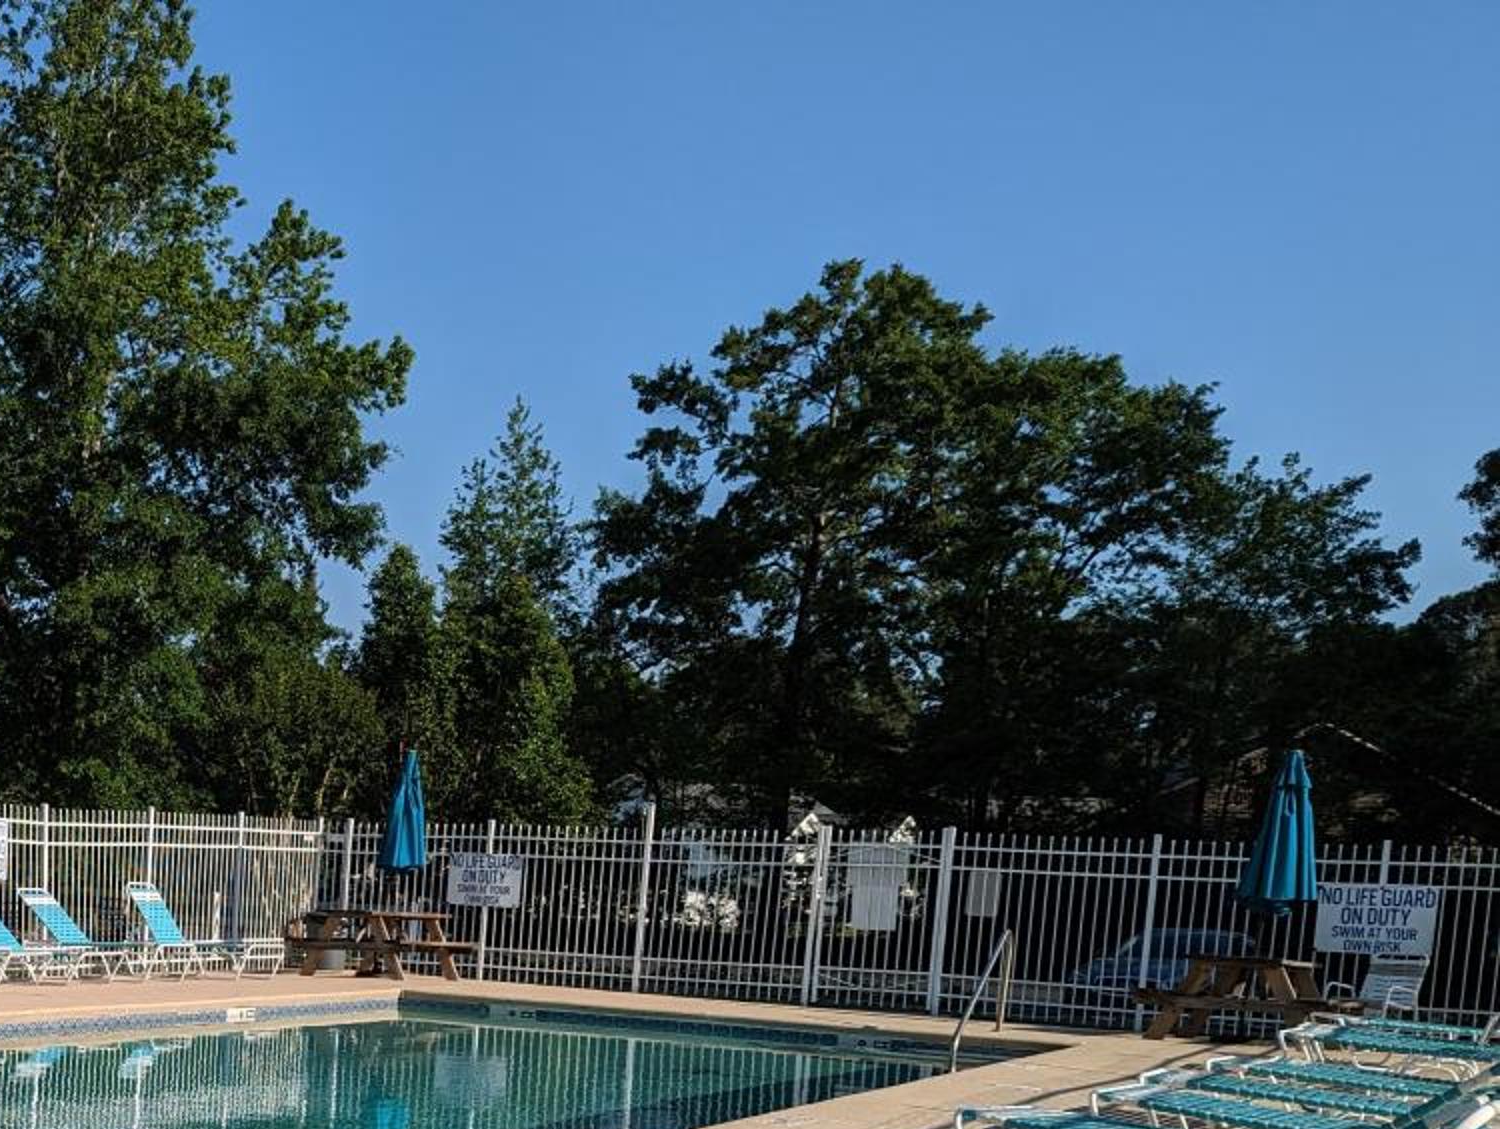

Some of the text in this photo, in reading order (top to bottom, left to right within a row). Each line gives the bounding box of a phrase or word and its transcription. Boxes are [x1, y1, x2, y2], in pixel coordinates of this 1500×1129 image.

[478, 869, 506, 884] DUTY
[1321, 887, 1437, 909] NO LIFE GUARD
[1341, 907, 1412, 926] ON DUTY
[1331, 926, 1418, 941] SWIM AT YOUR
[1343, 939, 1401, 953] OWN RISK
